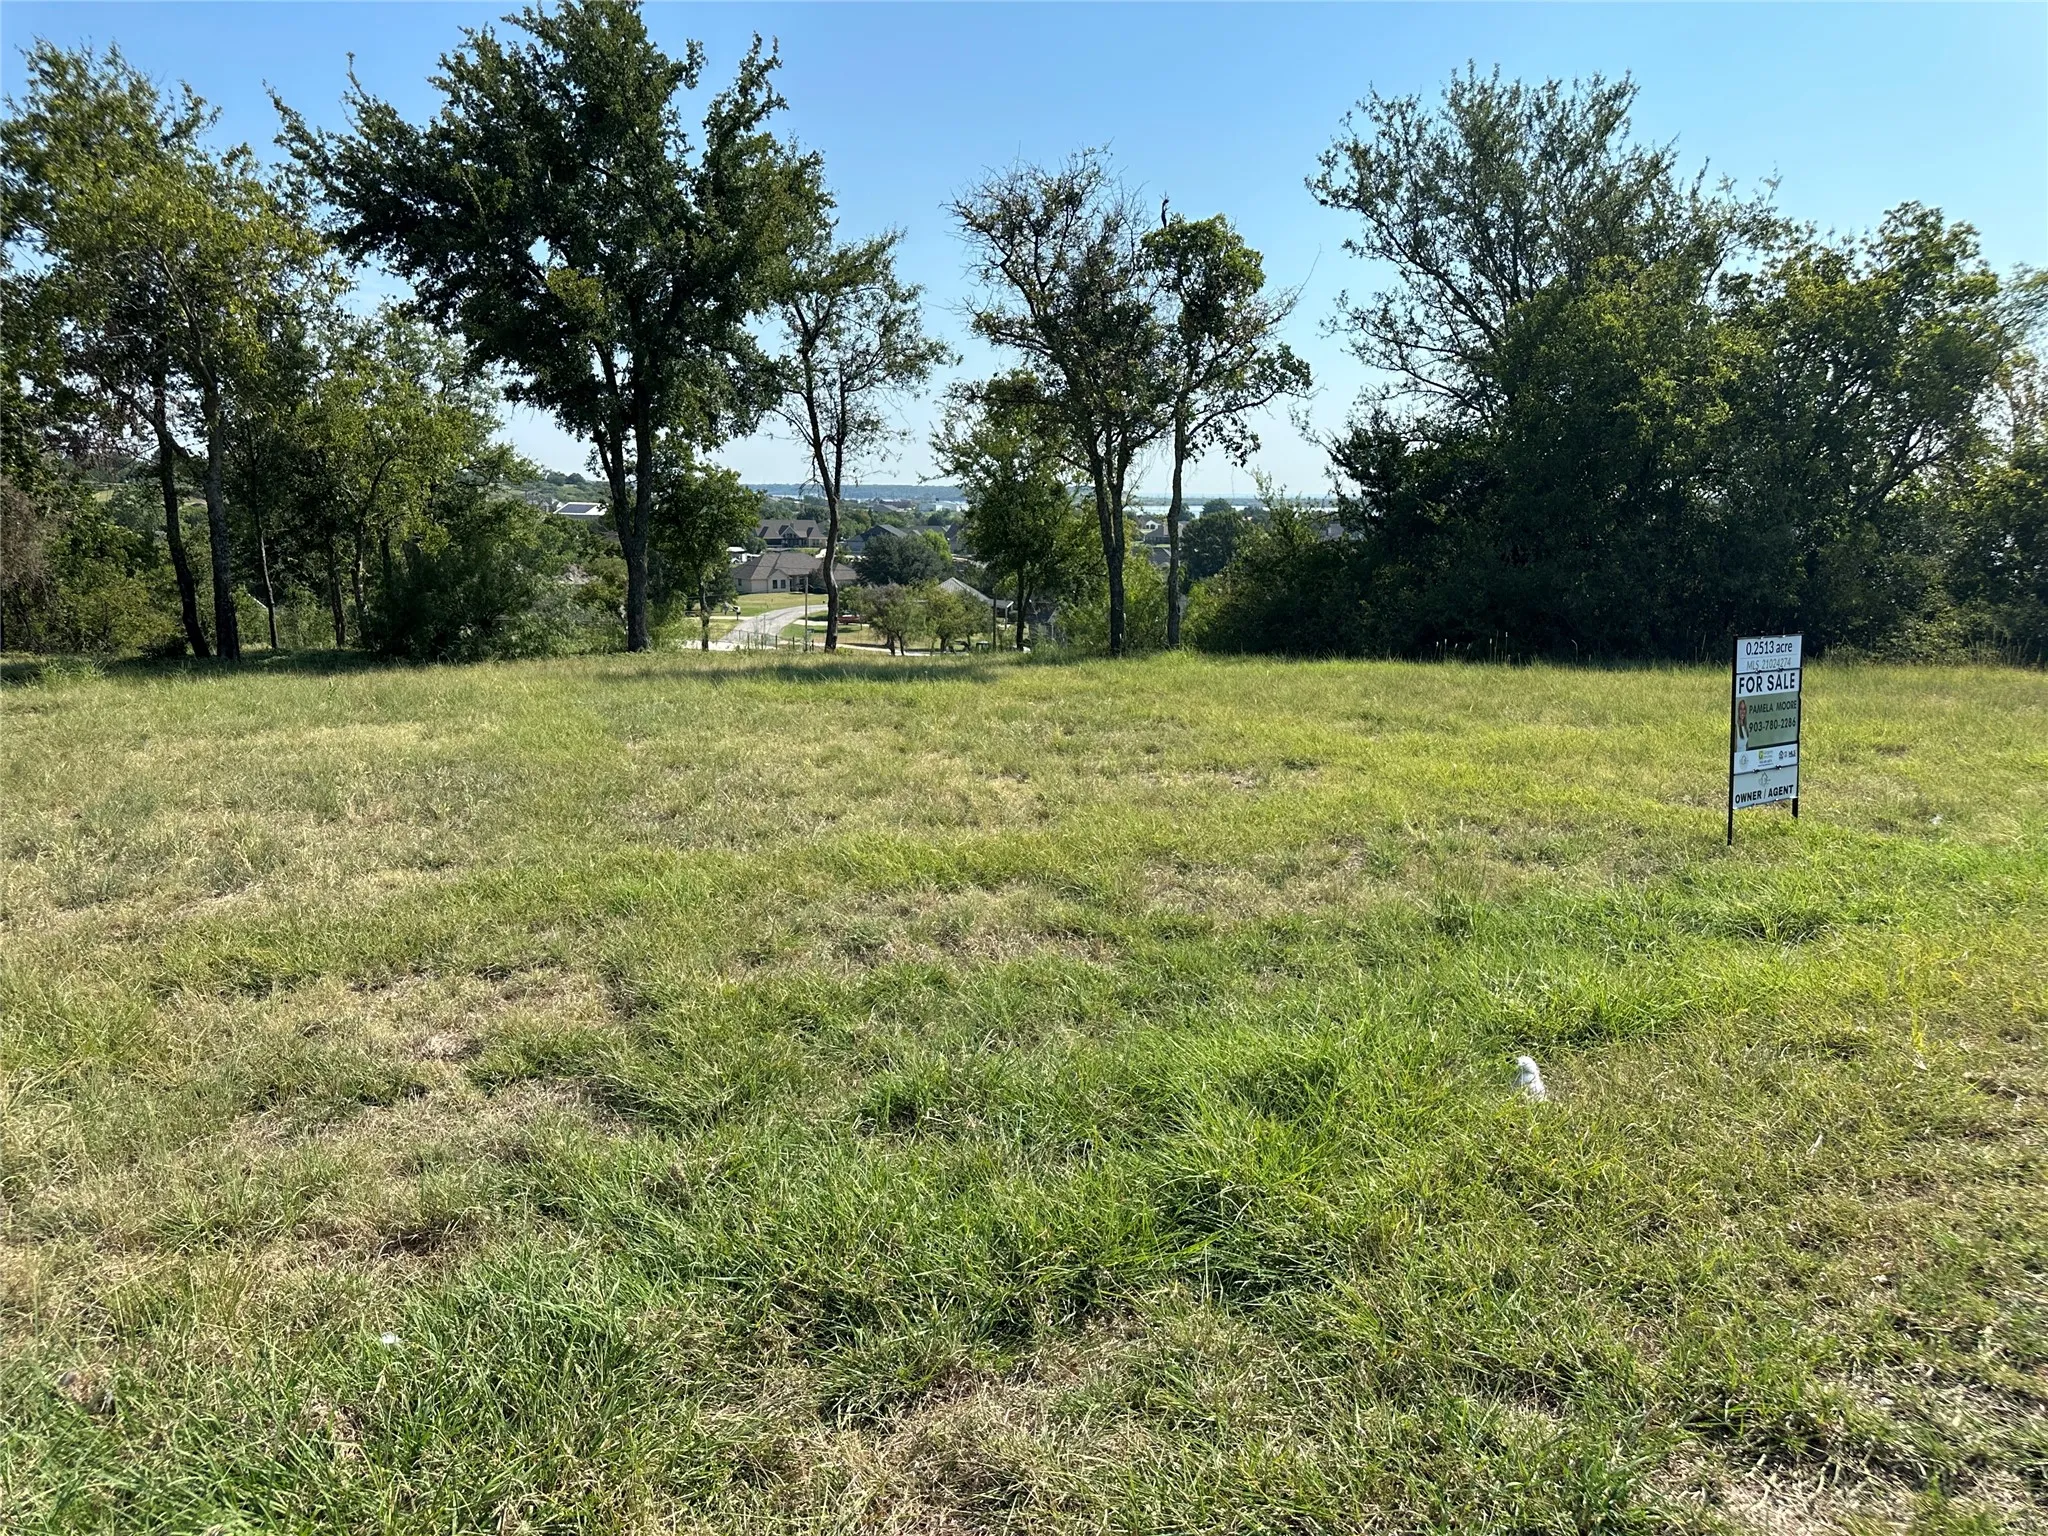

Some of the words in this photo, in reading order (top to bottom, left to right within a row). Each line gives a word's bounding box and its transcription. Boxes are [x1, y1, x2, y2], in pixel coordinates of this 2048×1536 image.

[1746, 640, 1774, 655] 0.2513
[1776, 642, 1792, 653] acre
[1747, 660, 1760, 671] MLS
[1739, 676, 1762, 694] FOR
[1767, 673, 1795, 691] SALE
[1749, 703, 1773, 714] PAMELA
[1776, 700, 1797, 710] MOORE
[1749, 717, 1796, 733] 903-780-2286
[1735, 790, 1762, 803] OWNER
[1768, 785, 1794, 797] AGENT
